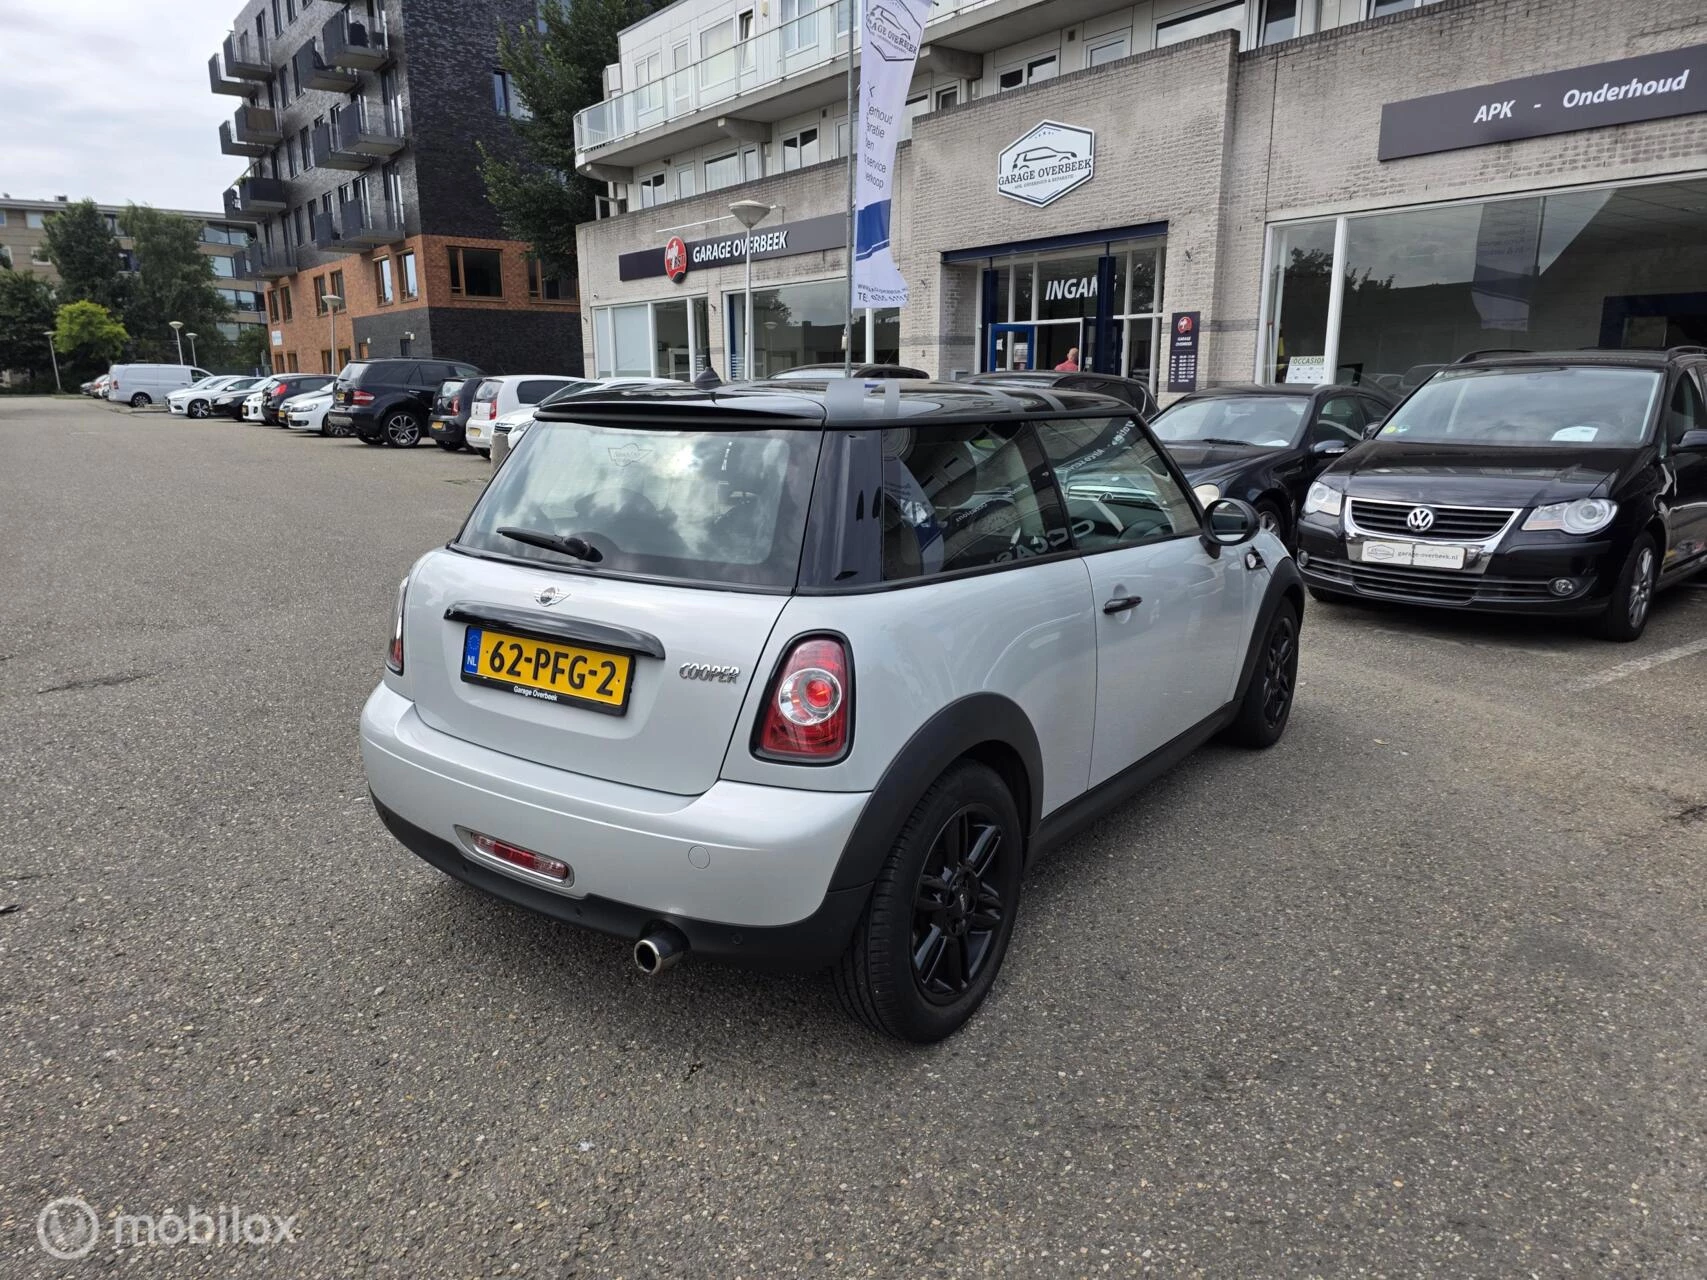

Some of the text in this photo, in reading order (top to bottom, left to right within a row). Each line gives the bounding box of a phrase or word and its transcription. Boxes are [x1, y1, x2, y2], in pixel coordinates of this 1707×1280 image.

[1472, 100, 1516, 123] APK
[1562, 68, 1690, 108] Onderhoud
[999, 158, 1092, 186] GARAGE OVERBEEK
[693, 241, 731, 262] GARAGE
[1045, 273, 1117, 301] INGAN
[466, 654, 477, 666] NL
[489, 640, 617, 697] 62-PFG-2
[679, 662, 740, 684] COOPER
[513, 685, 558, 701] Garage Overbeek
